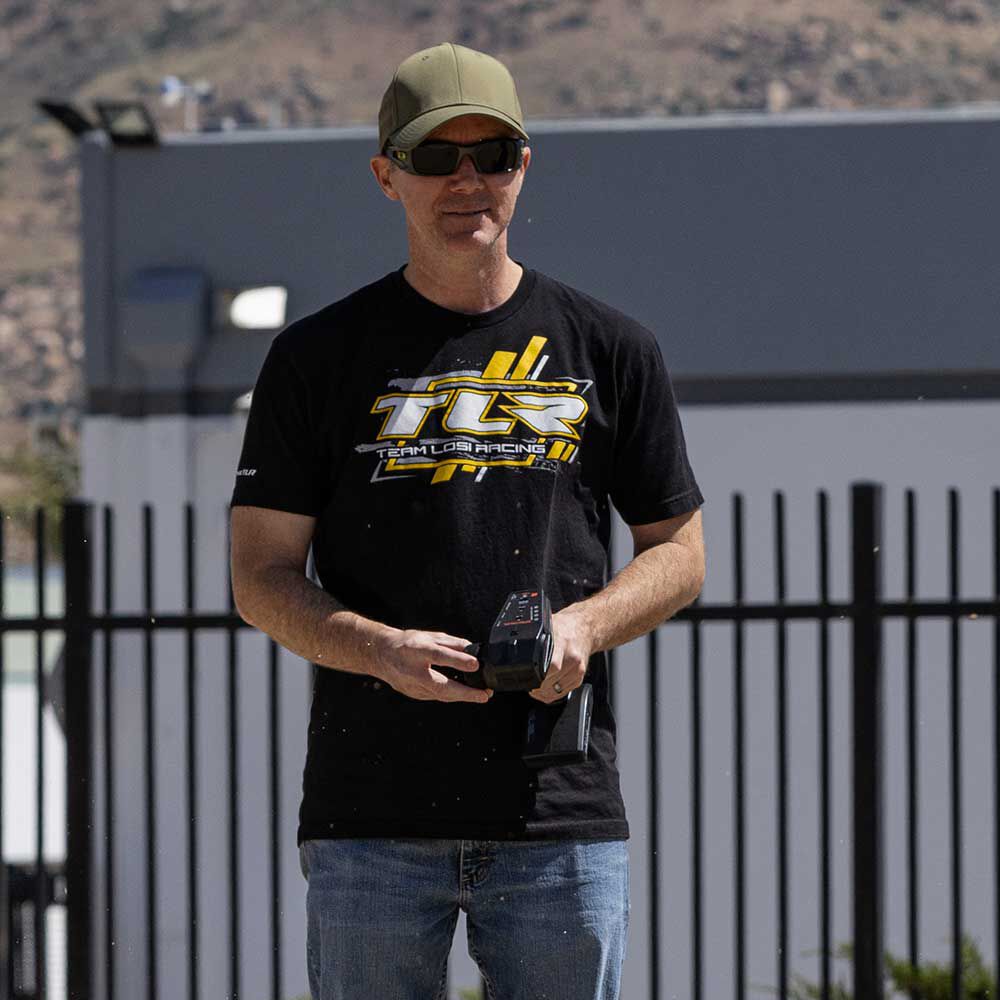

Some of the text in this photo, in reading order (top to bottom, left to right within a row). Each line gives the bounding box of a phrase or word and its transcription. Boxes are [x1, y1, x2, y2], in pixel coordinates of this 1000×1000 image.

[369, 388, 589, 440] TLR
[376, 441, 546, 458] TEAM LOSI RACING
